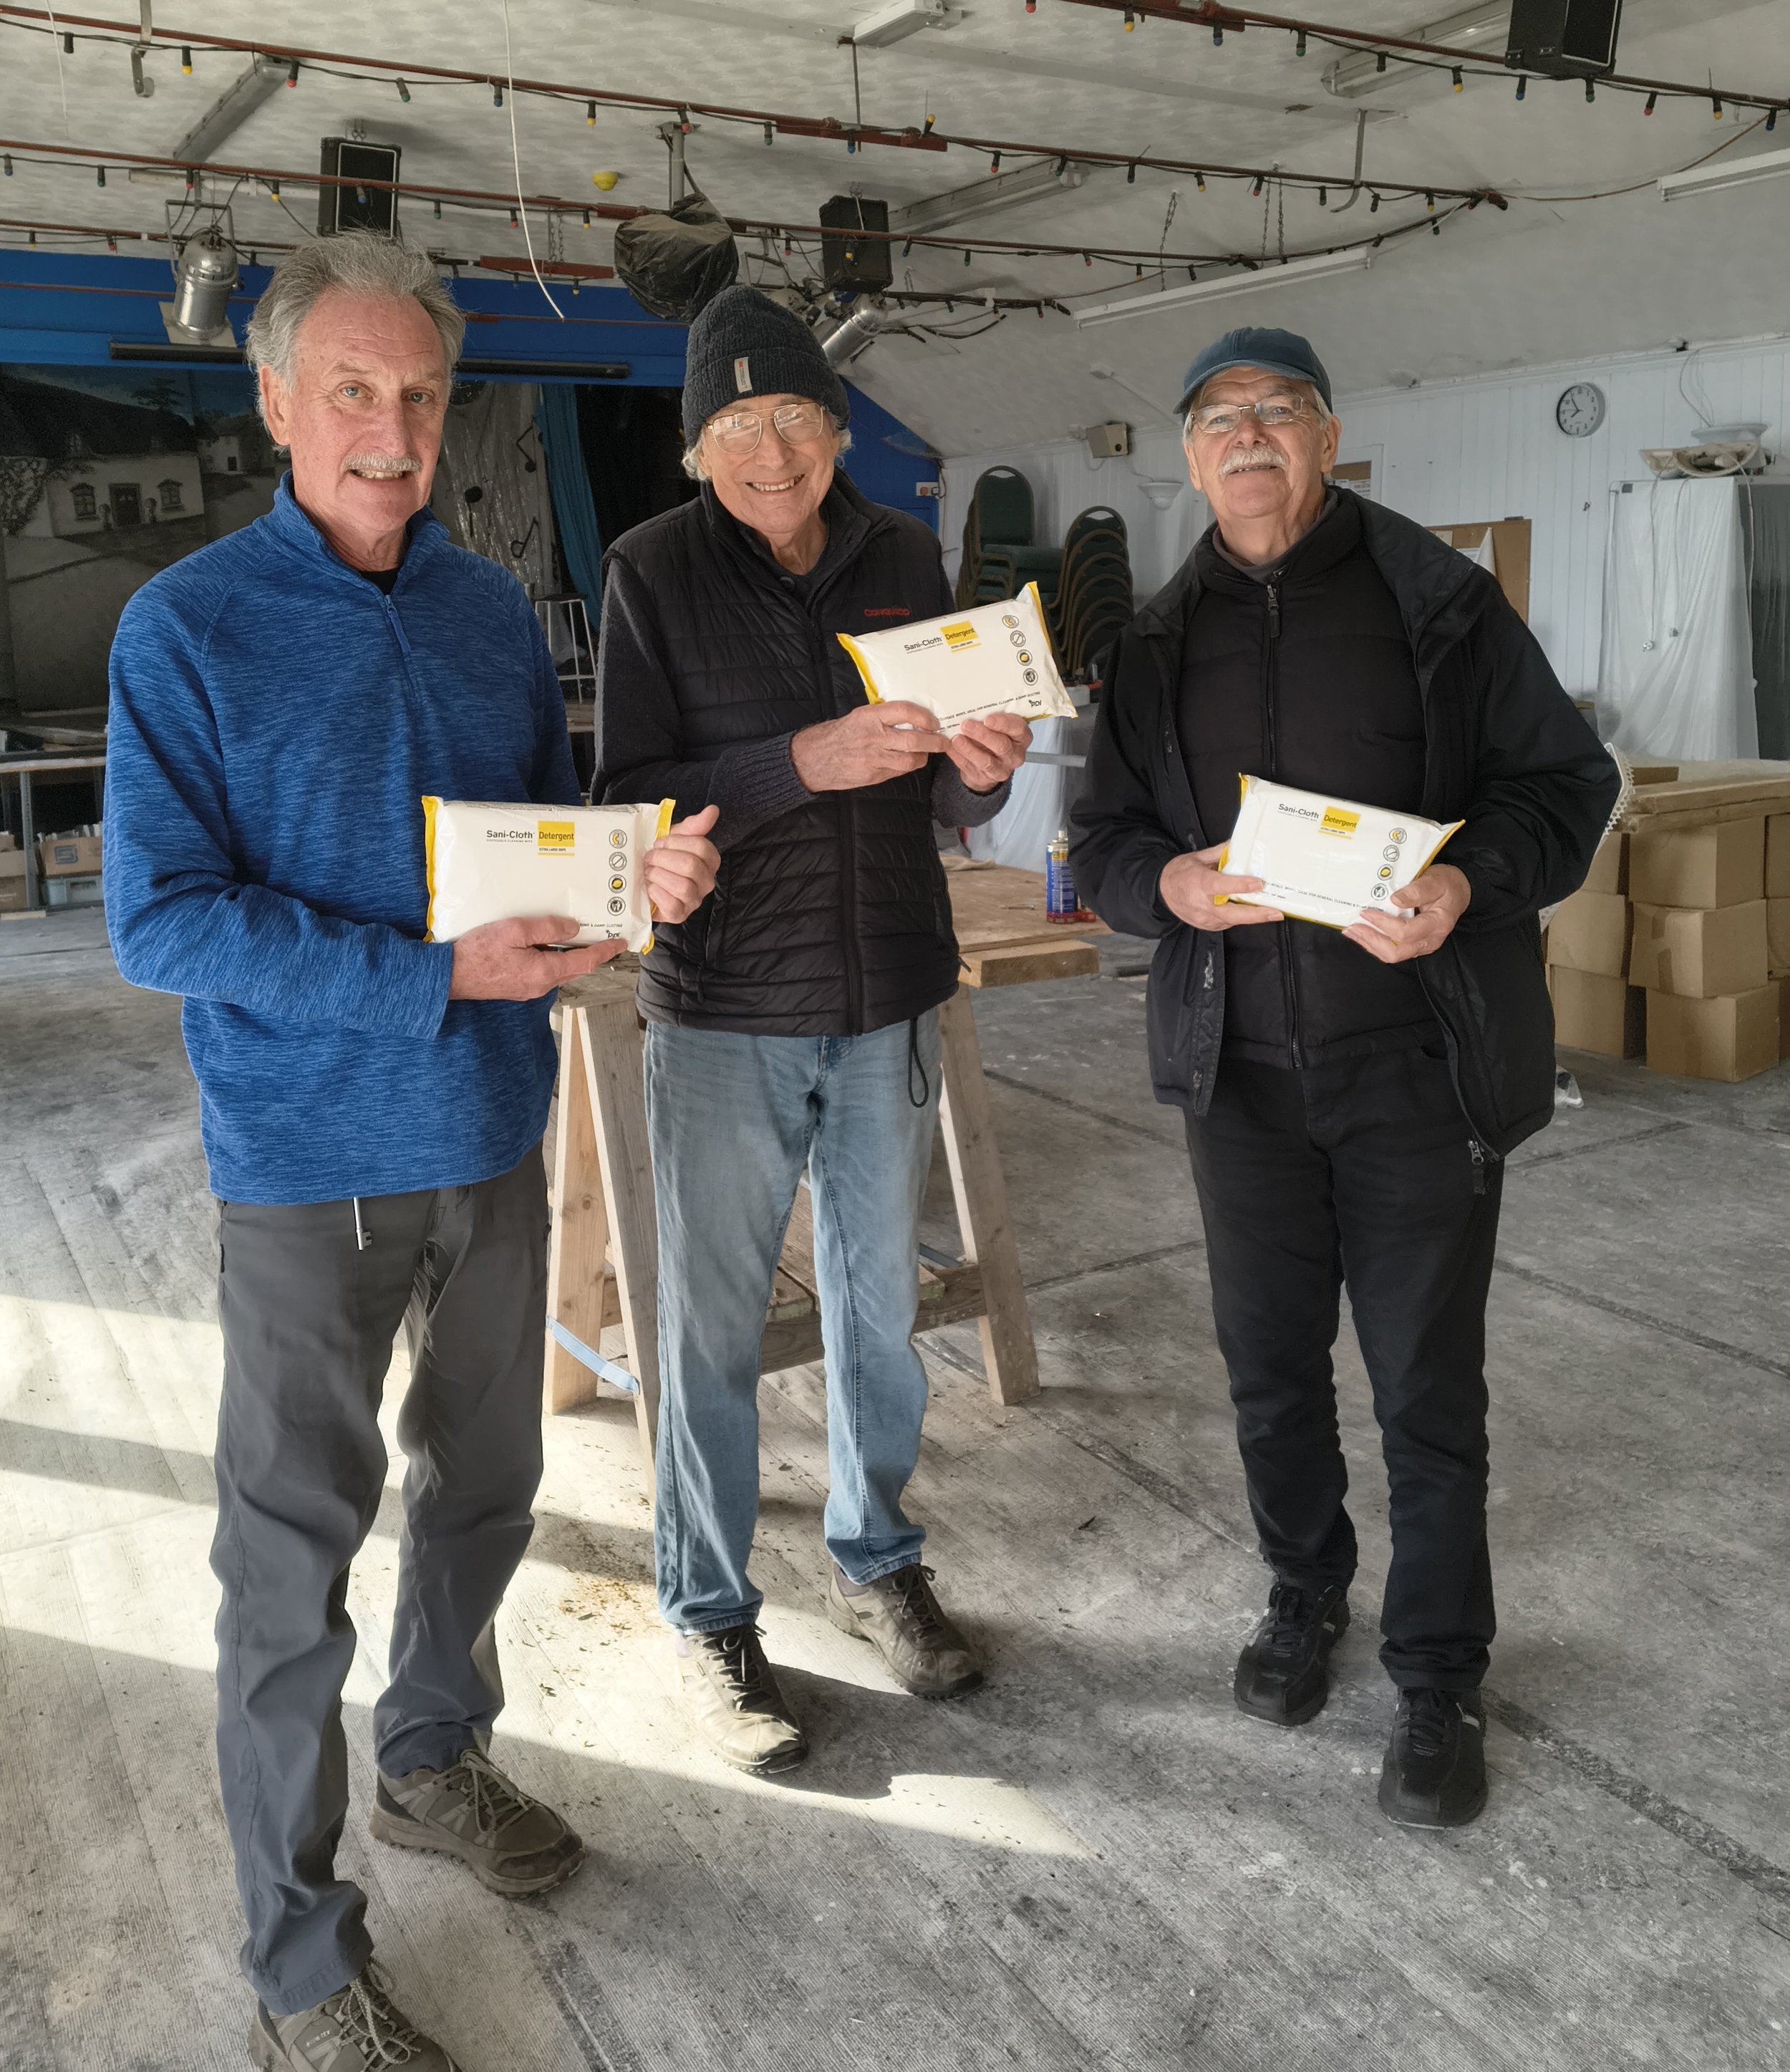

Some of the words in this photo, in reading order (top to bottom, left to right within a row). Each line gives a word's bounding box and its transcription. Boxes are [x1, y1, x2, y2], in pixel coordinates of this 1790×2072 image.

[904, 636, 942, 651] Sani-Cloth
[945, 628, 976, 640] Detergent
[1279, 803, 1320, 818] Sani-Cloth
[1324, 814, 1357, 828] Detergent
[486, 830, 533, 839] Sani-Cloth
[538, 831, 574, 841] Detergent
